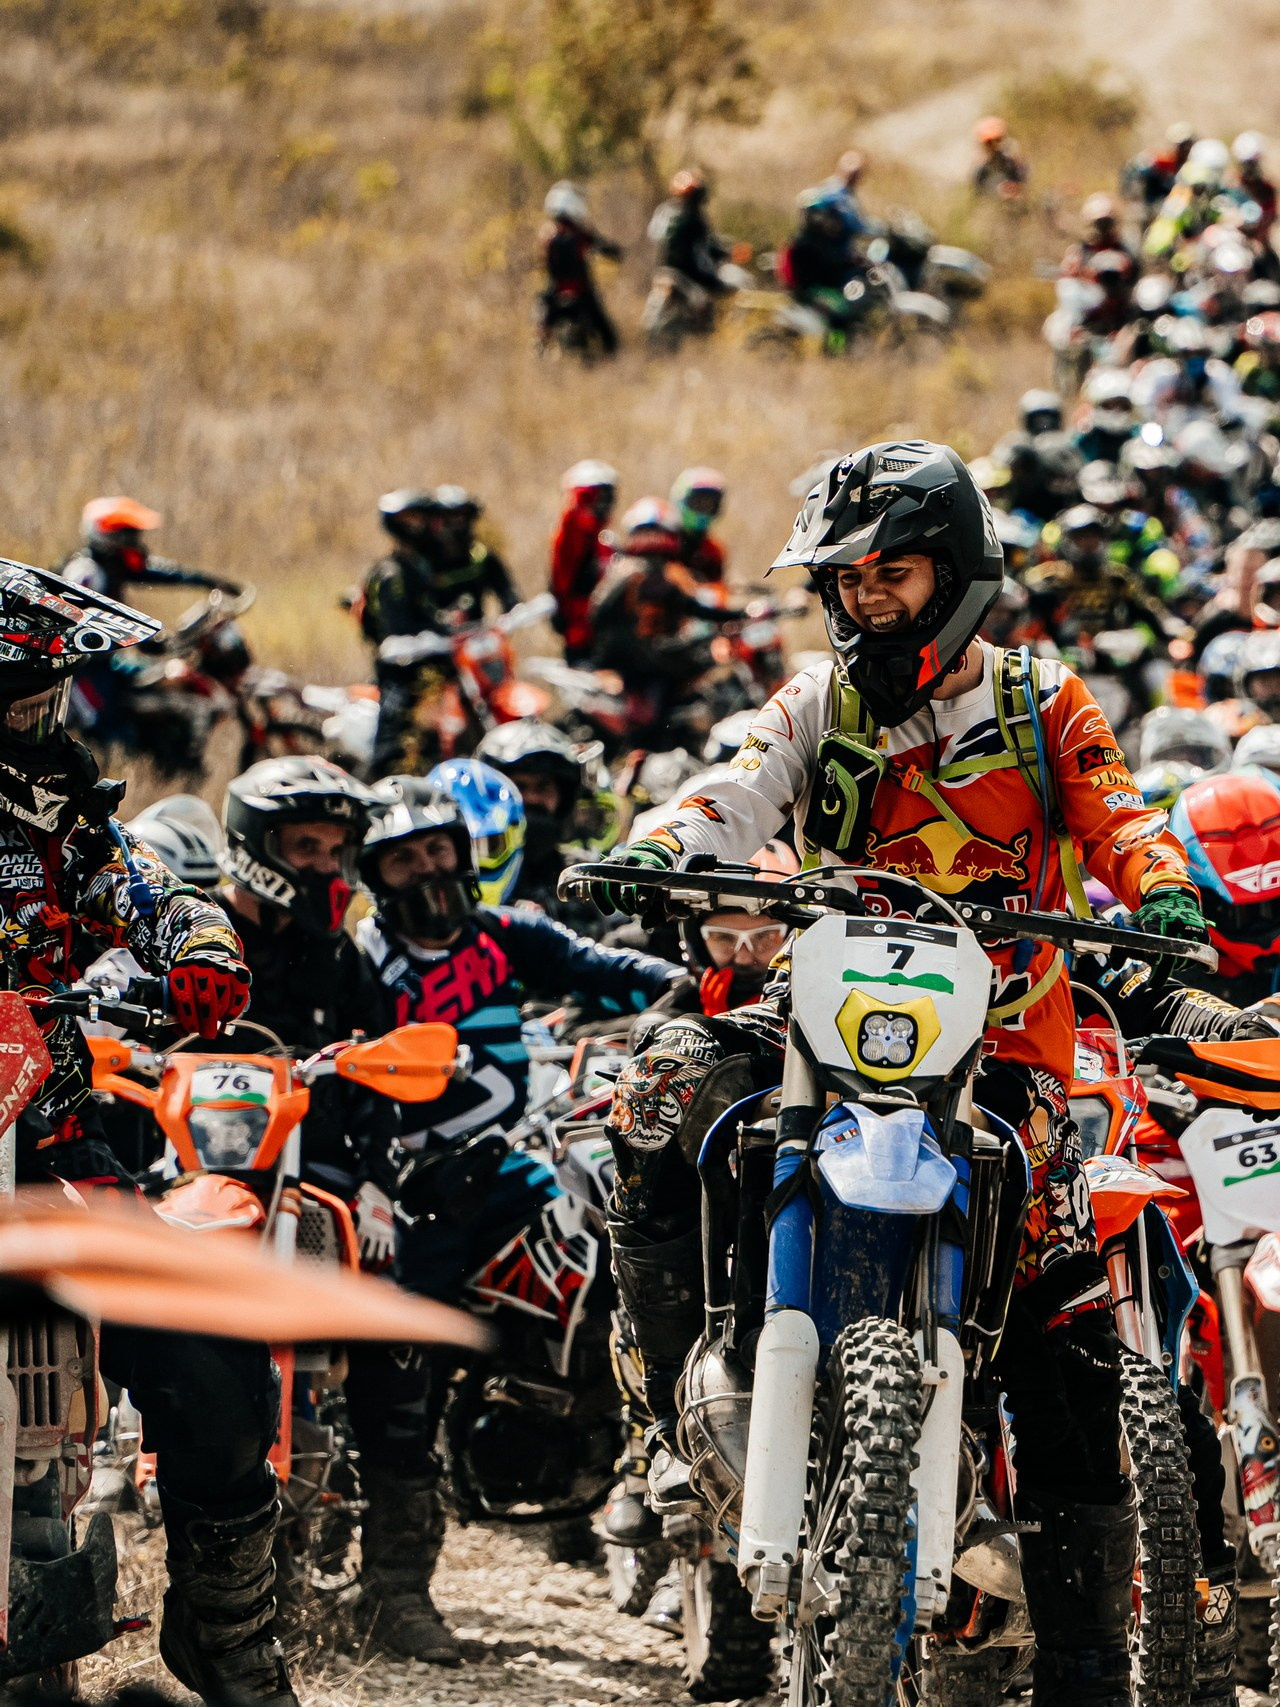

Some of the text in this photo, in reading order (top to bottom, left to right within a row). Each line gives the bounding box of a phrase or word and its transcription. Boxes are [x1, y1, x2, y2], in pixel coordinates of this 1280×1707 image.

[886, 943, 915, 970] 7
[213, 1074, 250, 1091] 76
[1238, 1142, 1278, 1167] 63
